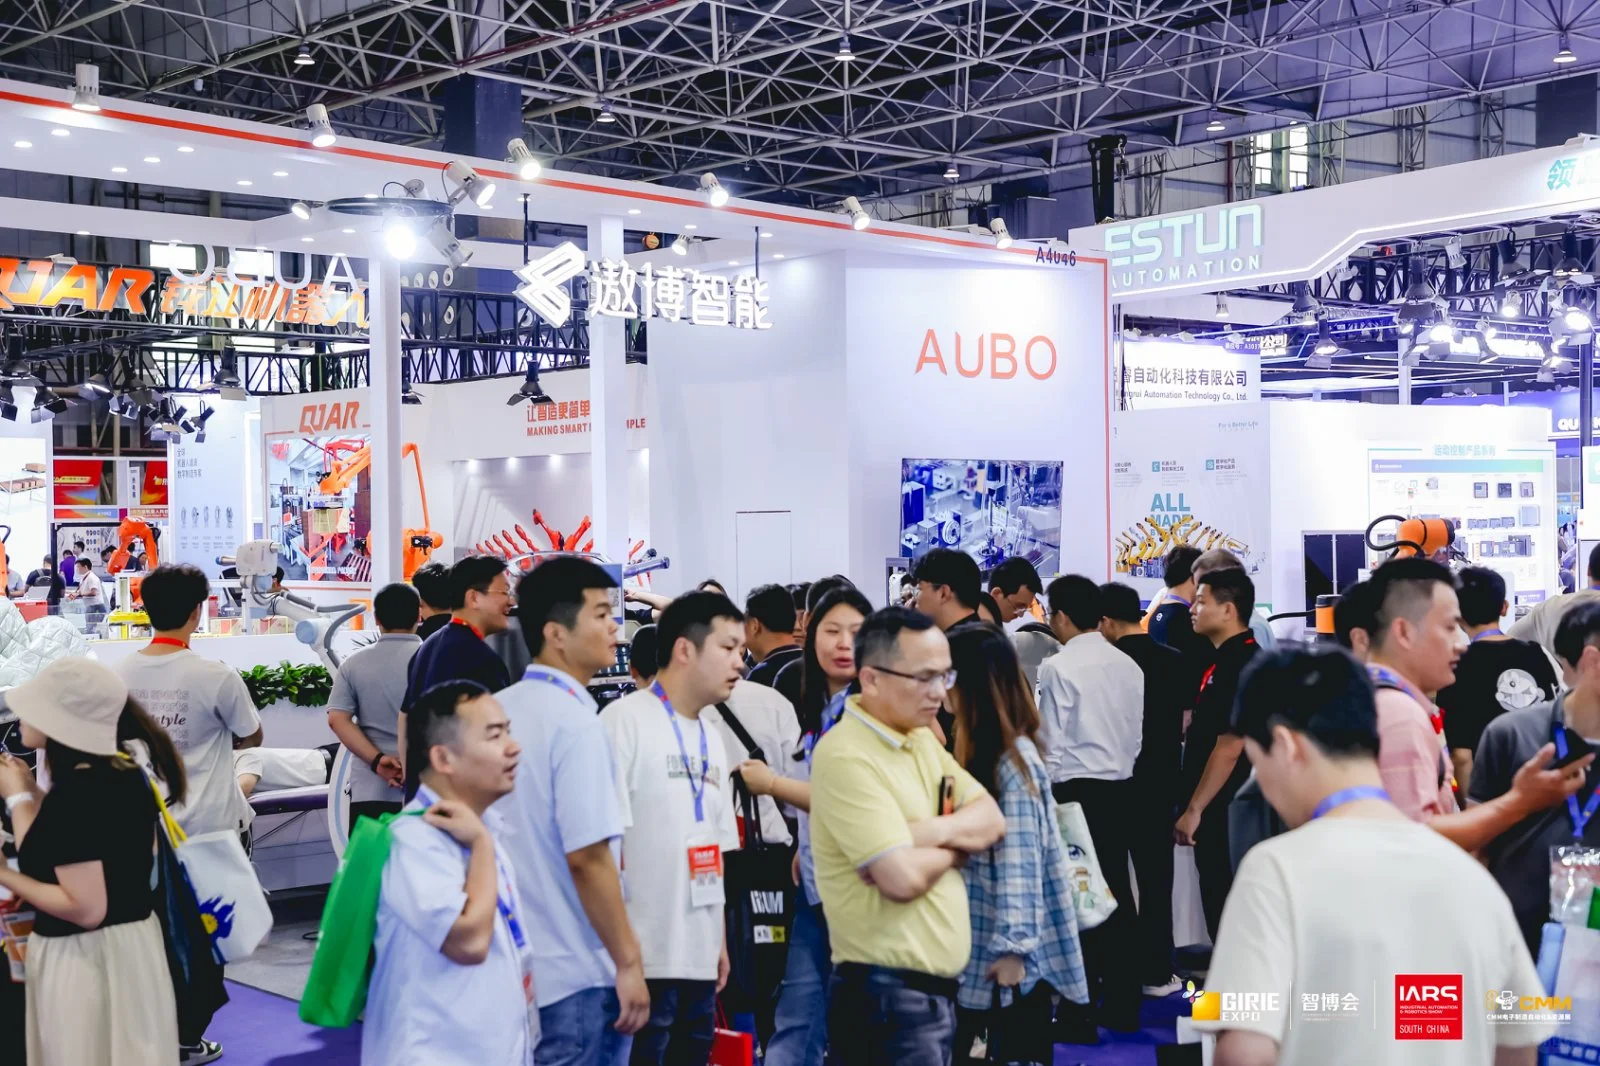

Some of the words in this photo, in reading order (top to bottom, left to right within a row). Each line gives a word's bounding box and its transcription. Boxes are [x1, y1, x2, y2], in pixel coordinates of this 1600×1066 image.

[1105, 205, 1261, 266] ESTUN
[588, 257, 773, 330] 遨博智能
[914, 328, 1058, 380] AUBO
[1114, 366, 1247, 387] 睿自动化科技有限公司
[1144, 390, 1182, 399] Automation
[1185, 391, 1220, 402] Technology
[299, 401, 359, 435] QJAR
[527, 426, 558, 436] MAKING
[560, 423, 588, 435] SMART
[1150, 493, 1191, 512] ALL
